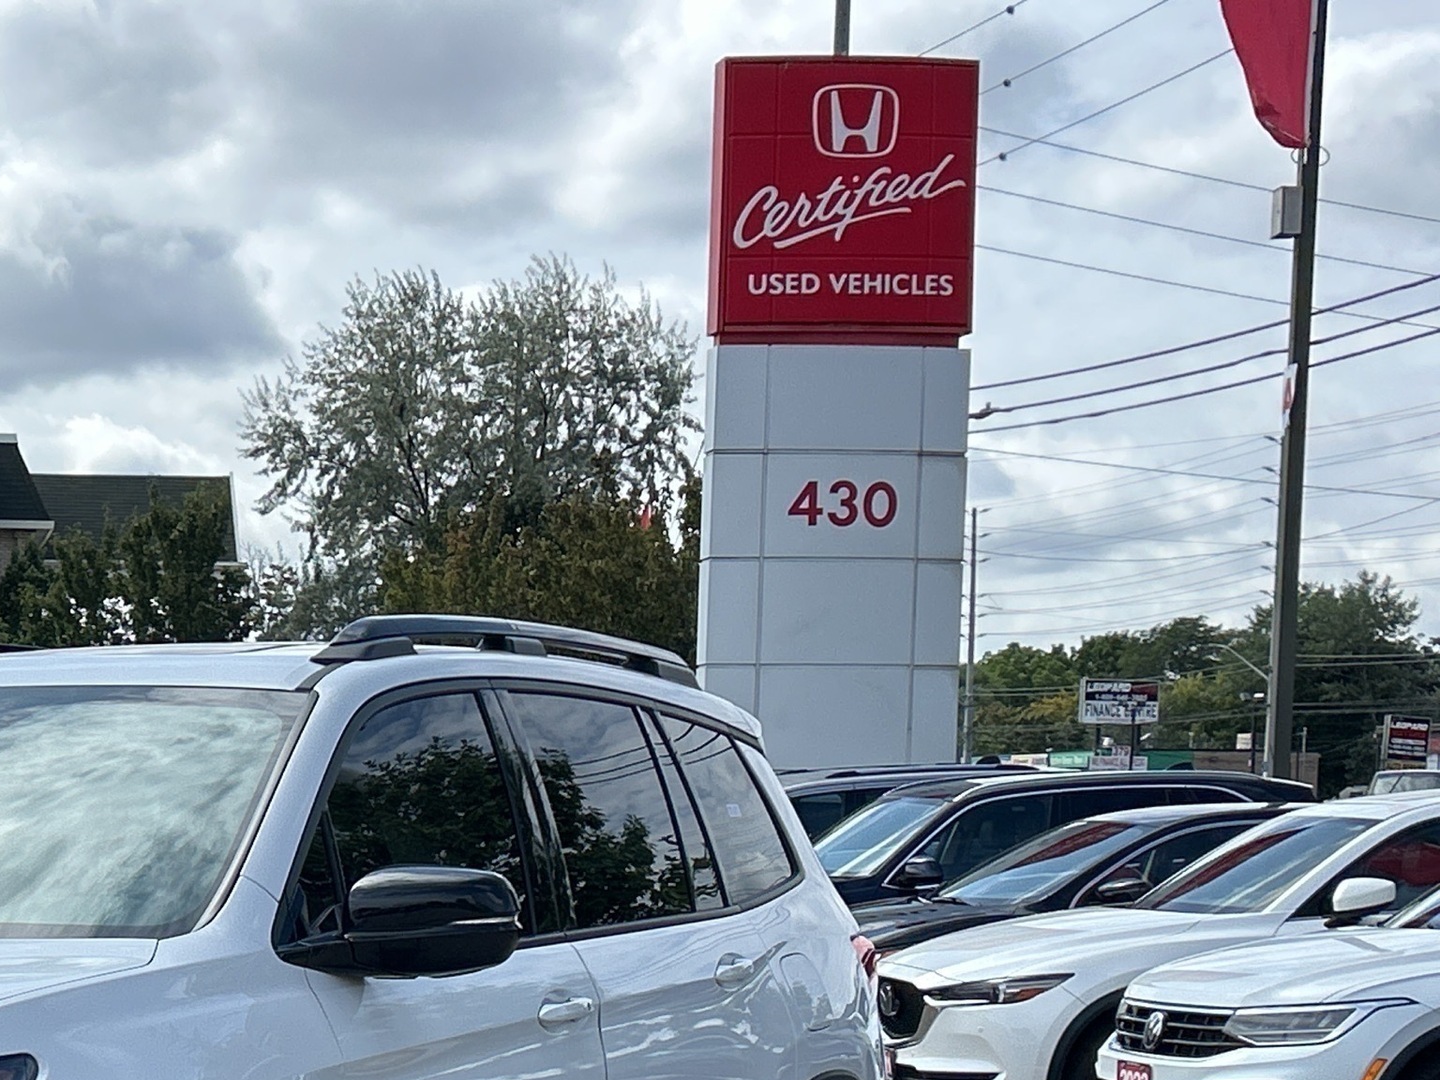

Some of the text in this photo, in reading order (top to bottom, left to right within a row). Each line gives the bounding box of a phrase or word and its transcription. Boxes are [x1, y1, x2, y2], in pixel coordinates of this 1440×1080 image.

[733, 154, 966, 249] Certified
[748, 273, 953, 296] USED VEHICLES
[788, 481, 897, 527] 430
[1085, 702, 1121, 718] FINANCE
